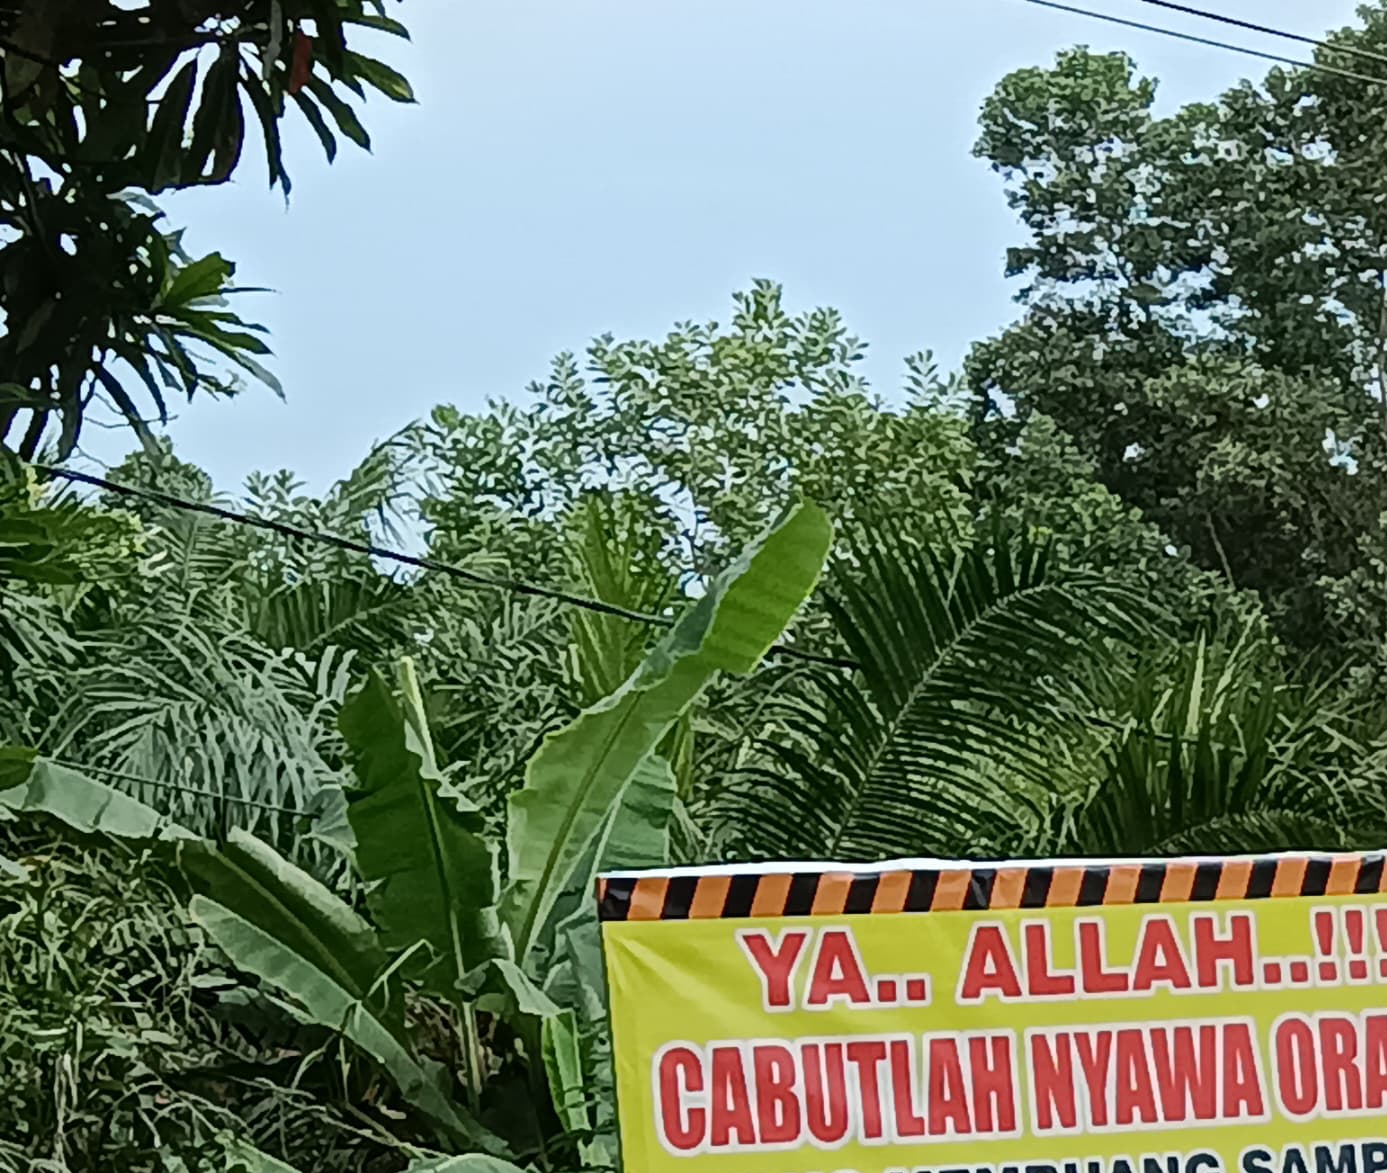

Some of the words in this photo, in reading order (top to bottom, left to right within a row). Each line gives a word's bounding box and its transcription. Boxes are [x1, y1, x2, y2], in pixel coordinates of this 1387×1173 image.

[743, 931, 928, 1008] YA..
[659, 1035, 1017, 1151] CABUTLAH
[1031, 1023, 1265, 1130] NYAWA
